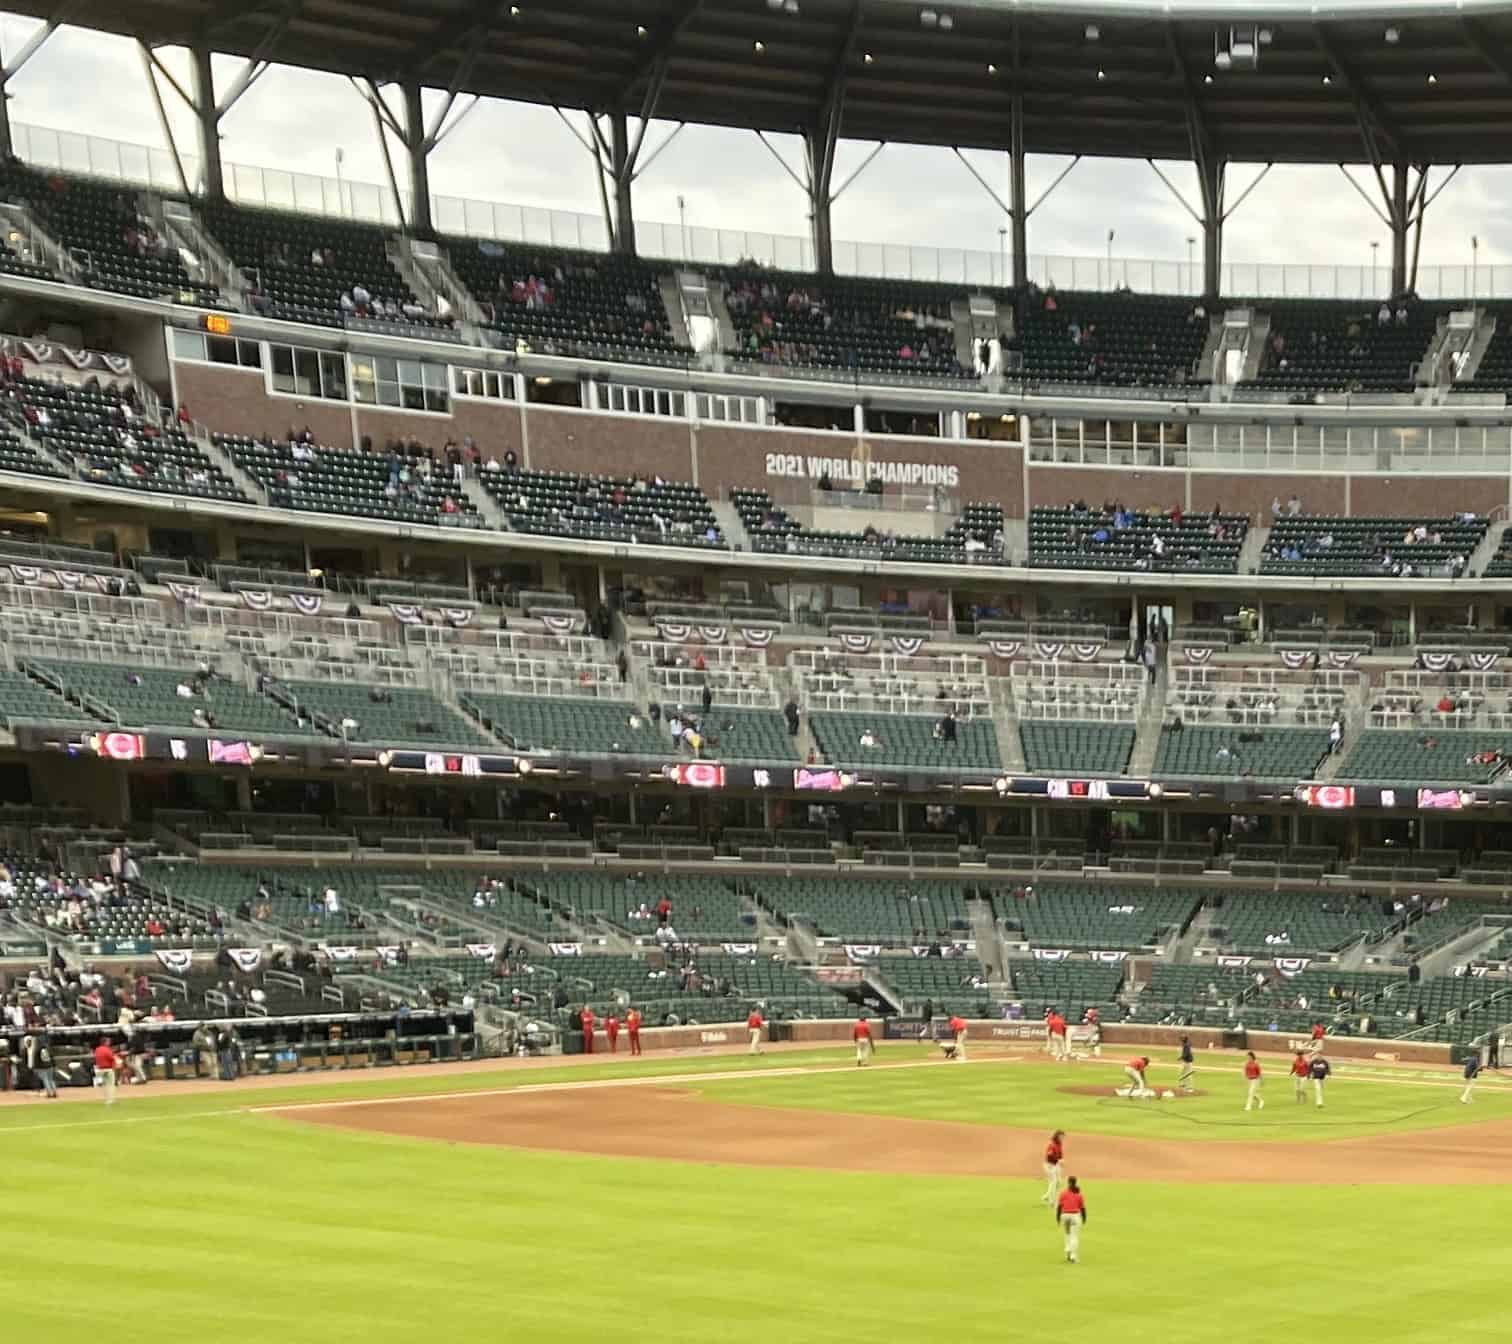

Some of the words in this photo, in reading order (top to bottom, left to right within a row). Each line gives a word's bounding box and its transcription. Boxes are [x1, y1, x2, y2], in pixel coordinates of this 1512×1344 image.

[765, 453, 805, 477] 2021
[807, 456, 860, 481] WORLD
[866, 461, 960, 486] CHAMPIONS
